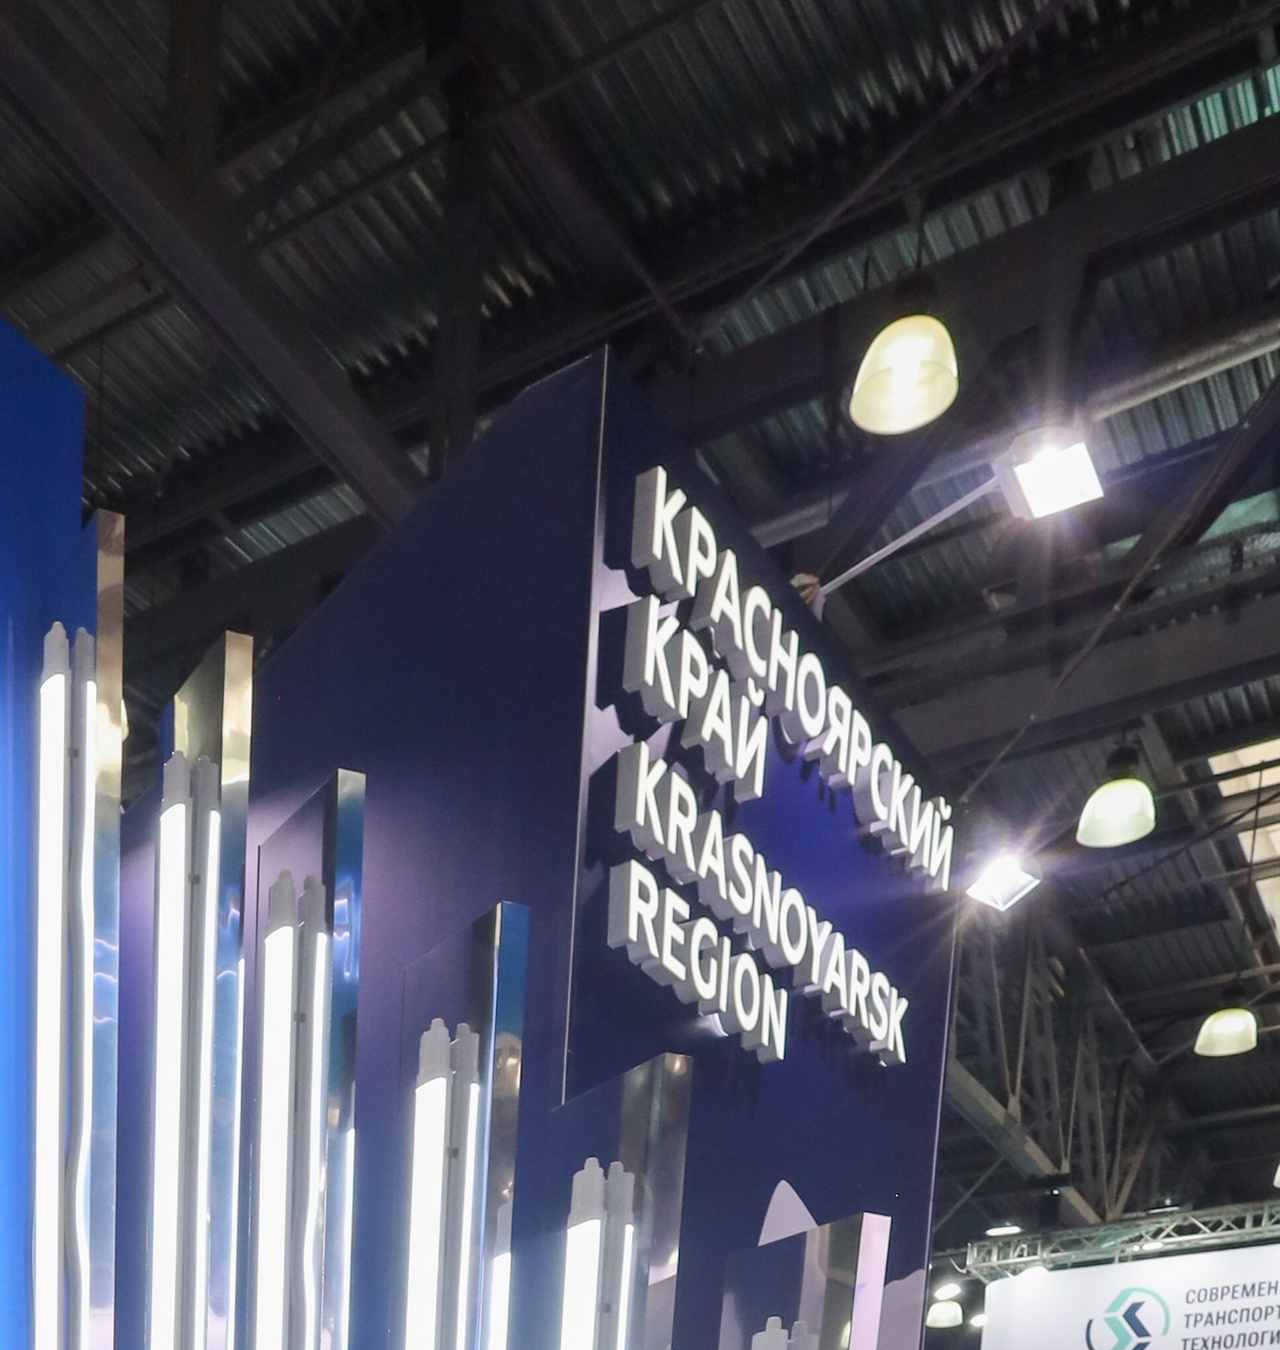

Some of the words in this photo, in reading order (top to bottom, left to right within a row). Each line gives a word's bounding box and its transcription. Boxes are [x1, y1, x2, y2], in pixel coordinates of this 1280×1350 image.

[624, 595, 768, 802] КРАЙ
[634, 465, 955, 892] КРАСНОЯРСКИЙ
[608, 859, 788, 1065] REGION
[616, 740, 910, 1065] KRASNOYARSK
